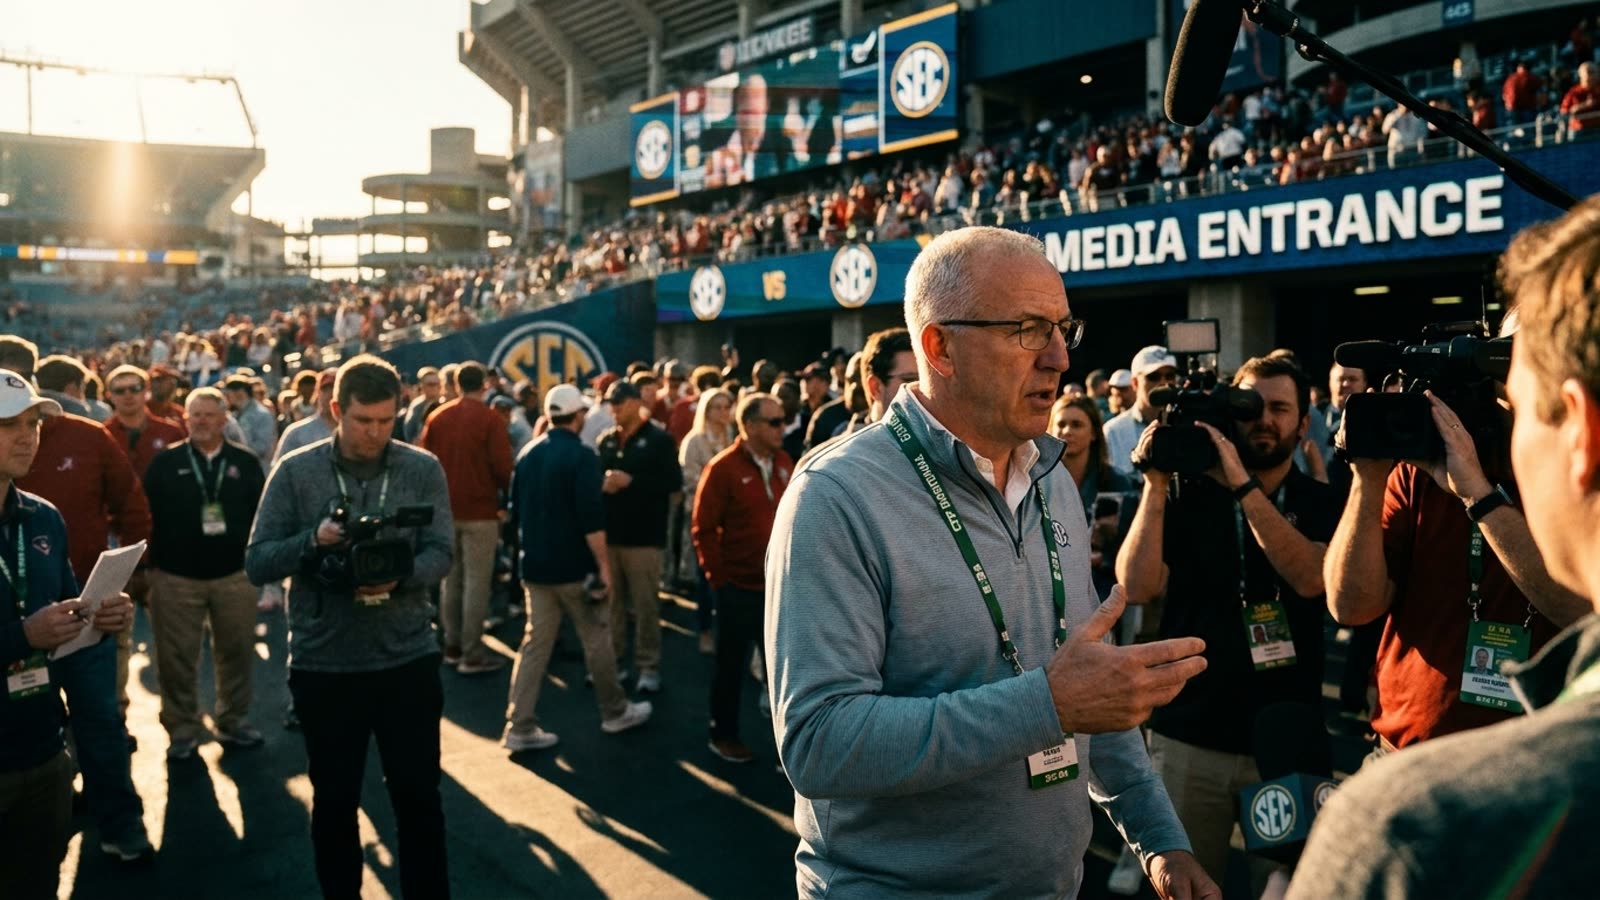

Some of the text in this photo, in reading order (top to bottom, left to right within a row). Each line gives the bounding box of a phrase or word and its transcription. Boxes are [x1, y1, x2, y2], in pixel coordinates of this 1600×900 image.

[897, 48, 943, 110] SEC
[1045, 174, 1505, 273] MEDIA ENTRANCE
[762, 270, 787, 301] VS
[835, 248, 872, 301] SEC
[1255, 789, 1292, 837] SEC
